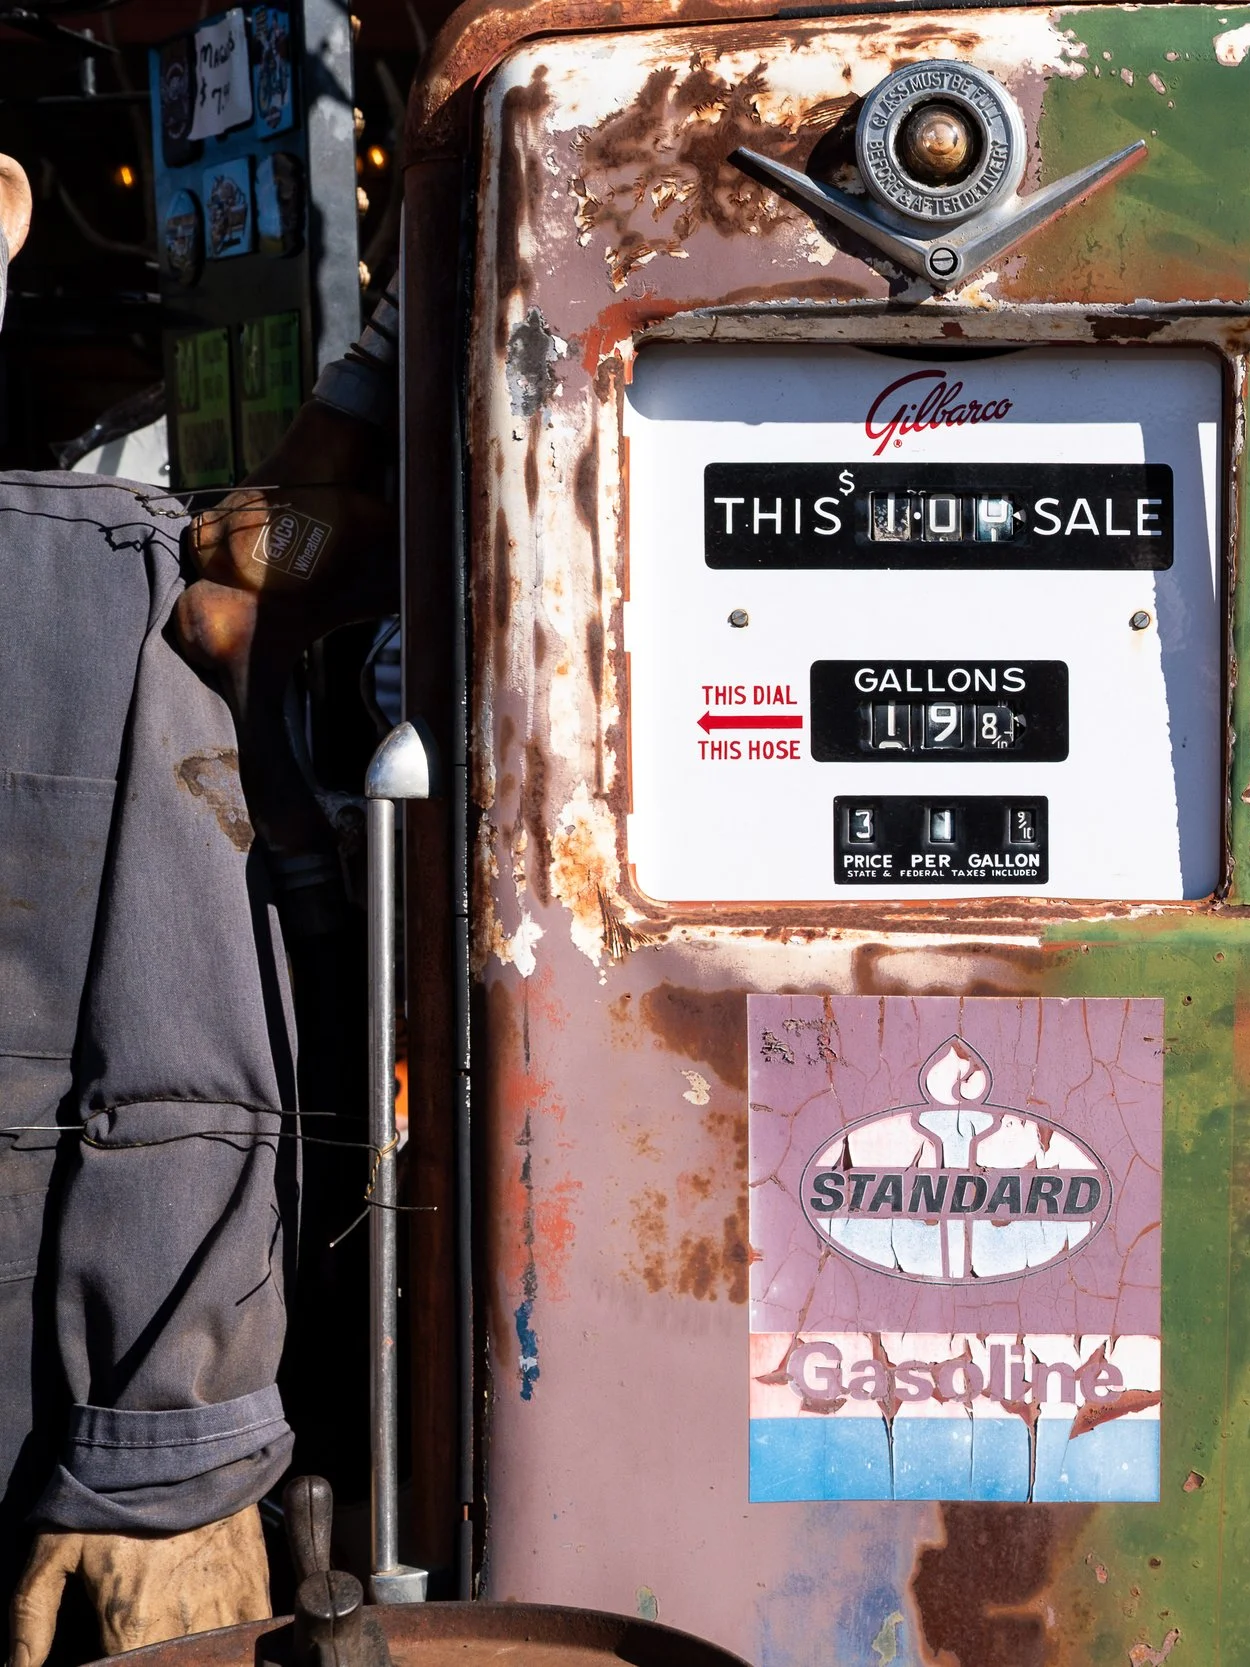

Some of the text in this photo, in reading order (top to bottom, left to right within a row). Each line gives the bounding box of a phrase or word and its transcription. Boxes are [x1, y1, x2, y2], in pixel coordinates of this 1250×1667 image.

[872, 71, 1002, 128] GLASS MUST BE FULL
[867, 140, 1009, 216] BEFORE & AFTER DELIVERY
[865, 369, 1013, 456] Gilbarco
[268, 516, 294, 559] EMCO
[713, 496, 842, 536] THIS
[1033, 497, 1163, 537] SALE
[293, 526, 325, 573] Wheaton
[702, 684, 798, 705] THIS DIAL
[854, 667, 1027, 693] GALLONS
[698, 740, 801, 760] THIS HOSE
[843, 854, 1040, 868] PRICE PER GALLON
[847, 869, 1038, 878] STATE & FEDERAL TAXES INCLUDED
[808, 1171, 1102, 1216] STANDARD
[786, 1339, 1125, 1407] Gasoline
